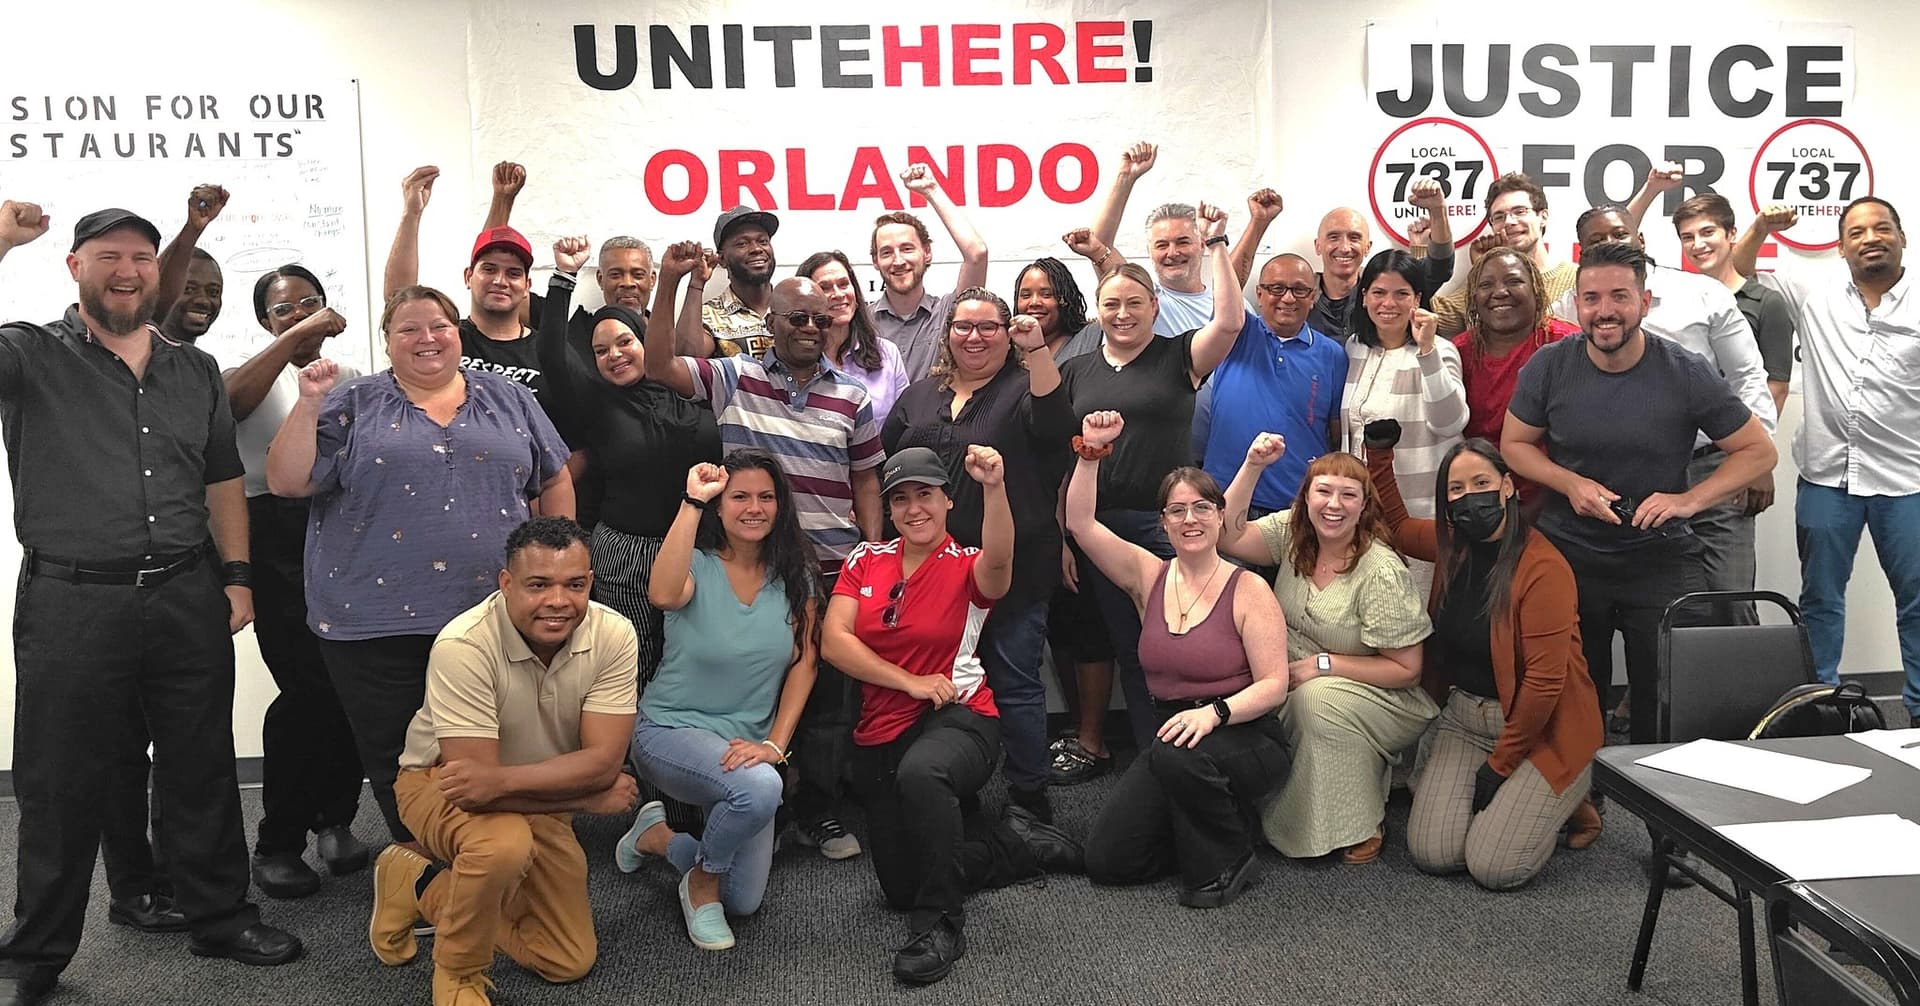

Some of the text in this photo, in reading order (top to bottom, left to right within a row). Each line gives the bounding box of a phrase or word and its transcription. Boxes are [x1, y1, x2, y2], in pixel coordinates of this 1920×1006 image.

[1376, 43, 1844, 118] JUSTICE
[145, 95, 219, 120] FOR
[249, 94, 325, 119] OUR
[1411, 147, 1456, 158] LOCAL
[1792, 147, 1835, 158] LOCAL
[644, 142, 1099, 216] ORLANDO
[1386, 160, 1484, 203] 737
[1522, 143, 1725, 217] FOR
[1766, 161, 1861, 201] 737
[1394, 204, 1477, 219] UNITERE!
[460, 356, 541, 383] RESPECT
